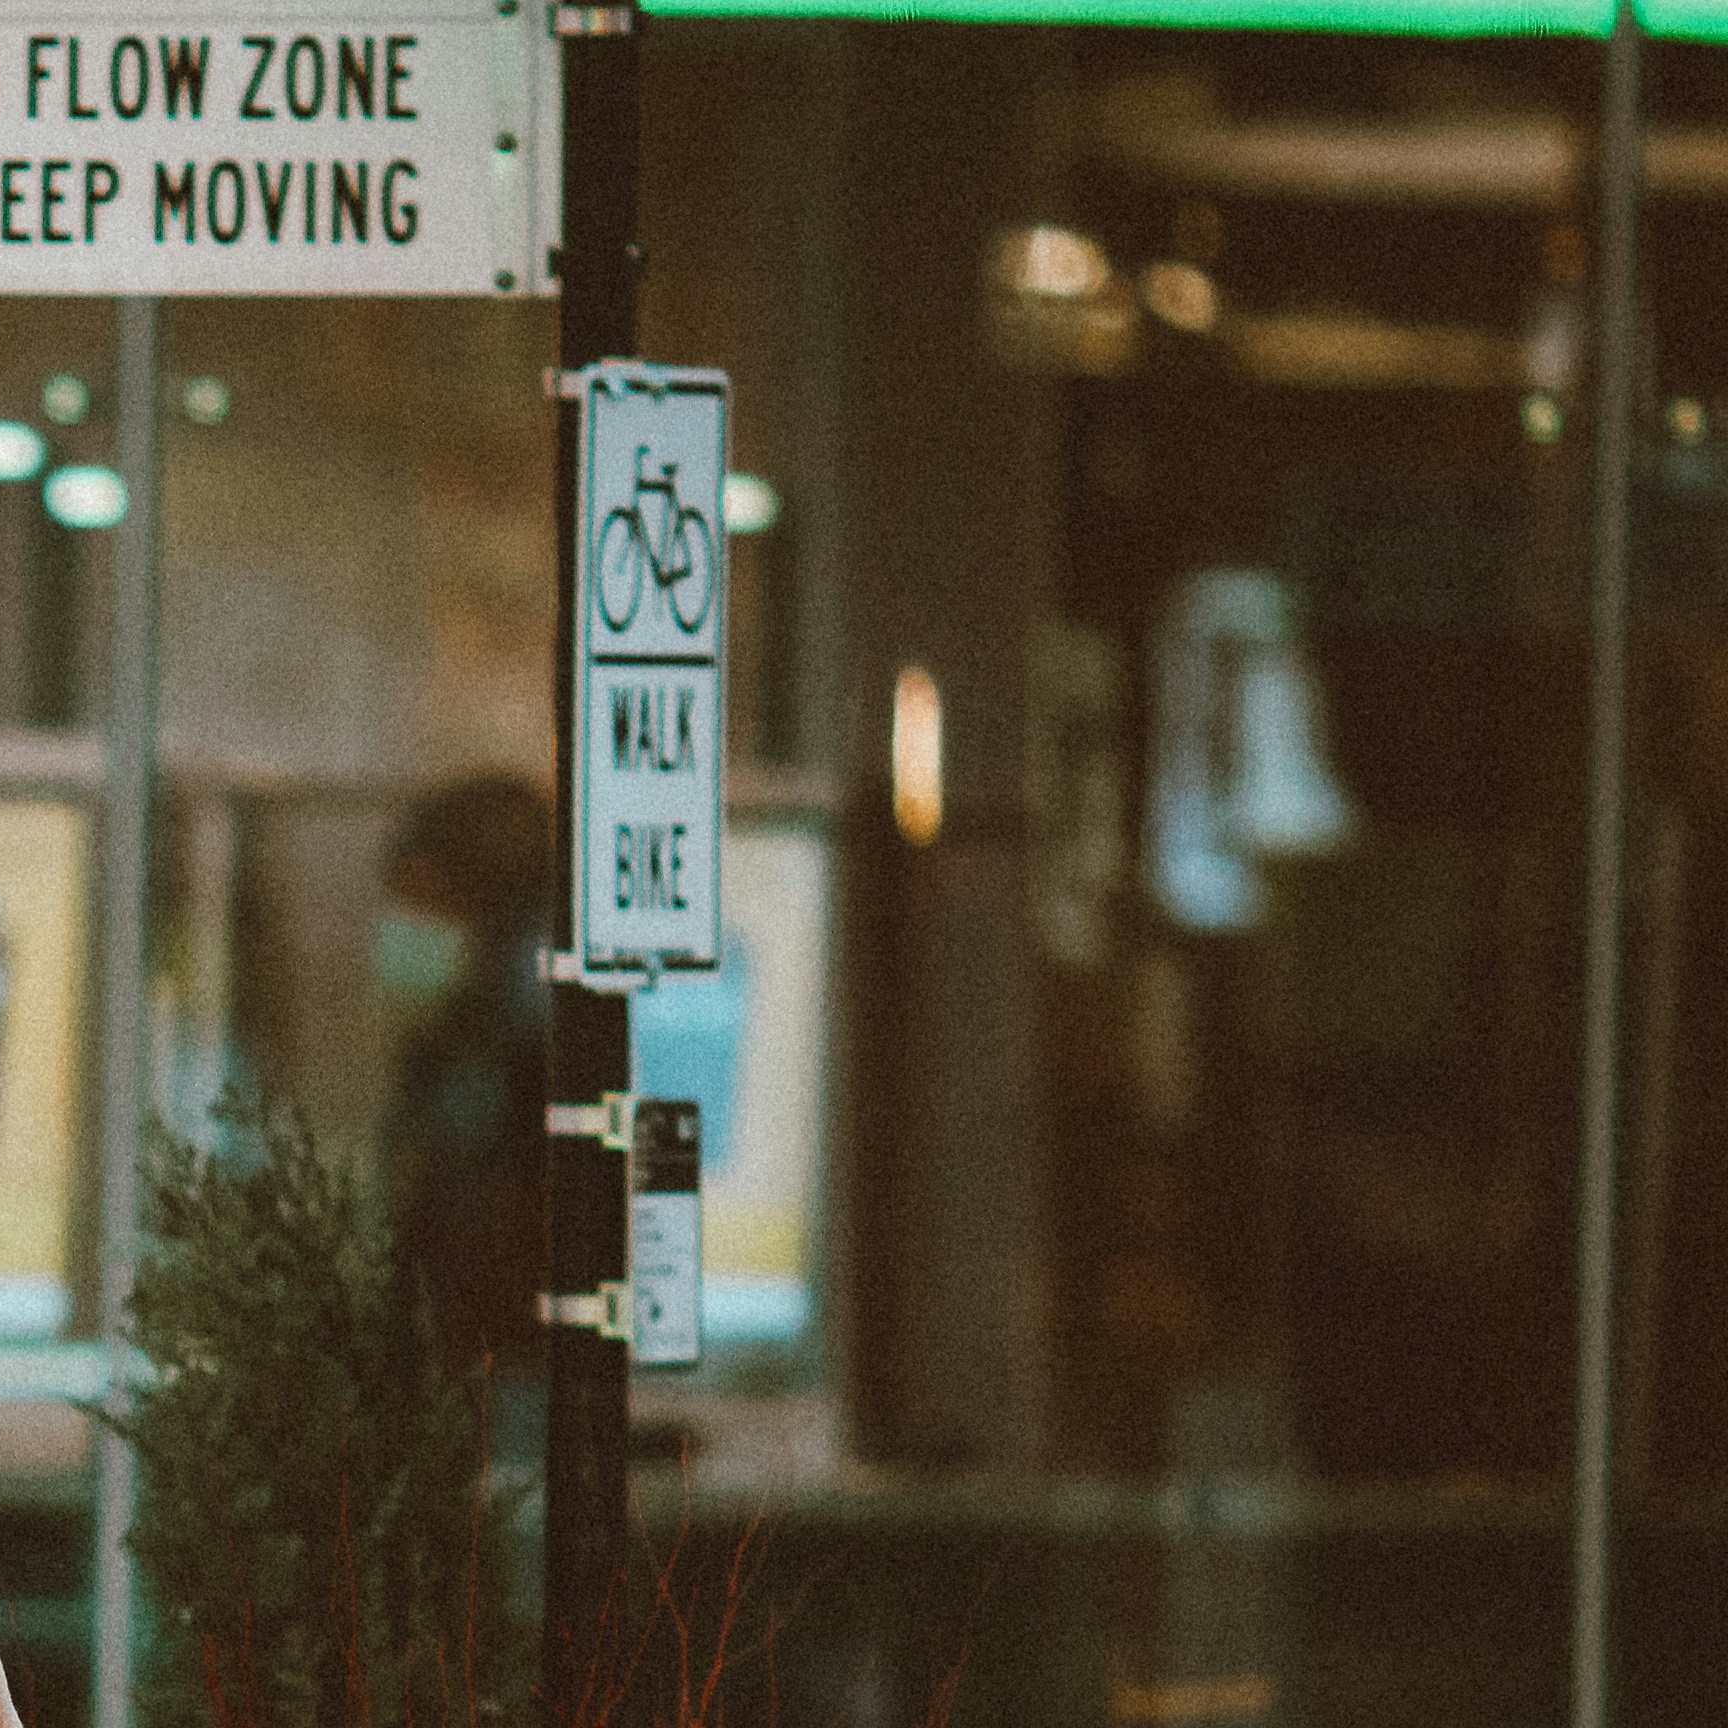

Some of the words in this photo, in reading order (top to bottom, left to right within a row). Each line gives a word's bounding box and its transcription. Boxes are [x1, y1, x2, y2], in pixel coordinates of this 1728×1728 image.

[27, 34, 211, 120] FLOW
[240, 34, 419, 120] ZONE
[153, 159, 419, 245] MOVING
[611, 686, 696, 772] WALK
[616, 823, 688, 912] BIKE
